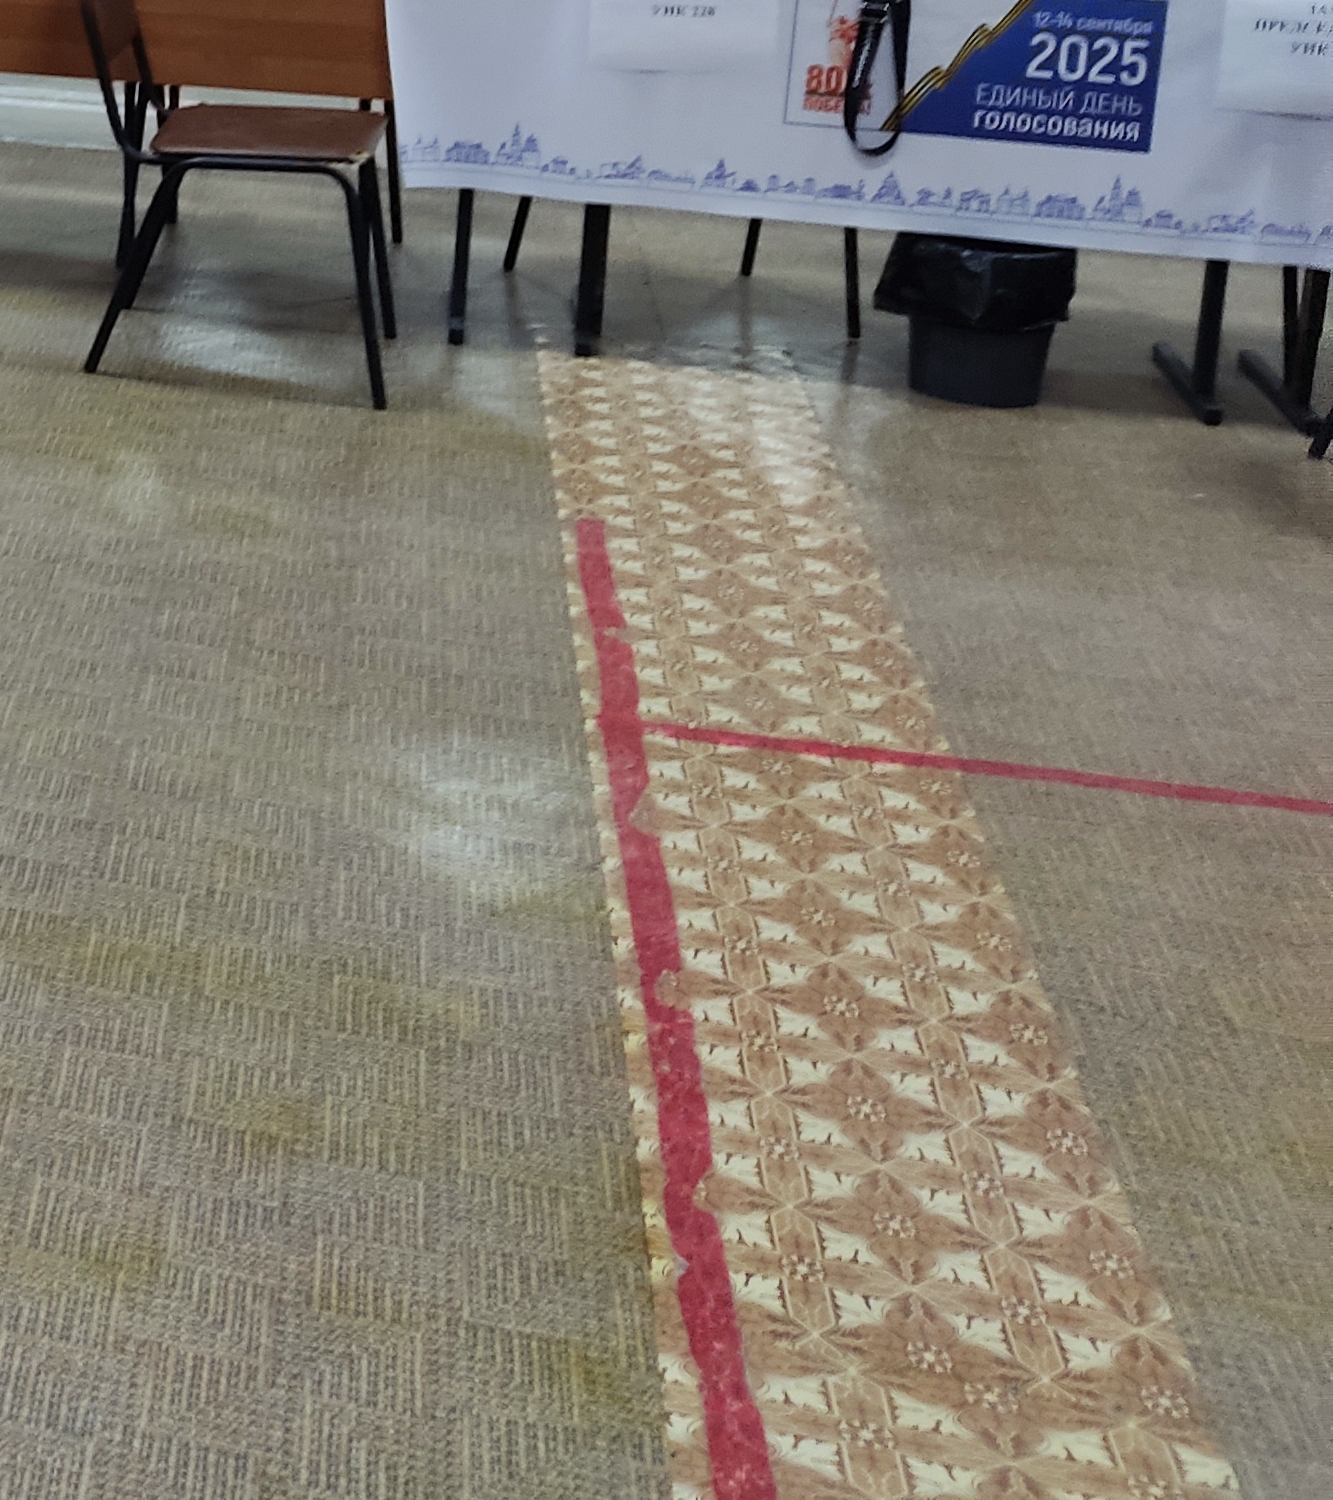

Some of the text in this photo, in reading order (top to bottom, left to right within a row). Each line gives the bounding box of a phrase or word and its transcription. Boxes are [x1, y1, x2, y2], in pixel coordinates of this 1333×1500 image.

[1033, 11, 1154, 35] 12-14 сентября
[1025, 31, 1150, 87] 2025
[976, 82, 1142, 117] ЕДИНЫЙ ДЕНЬ
